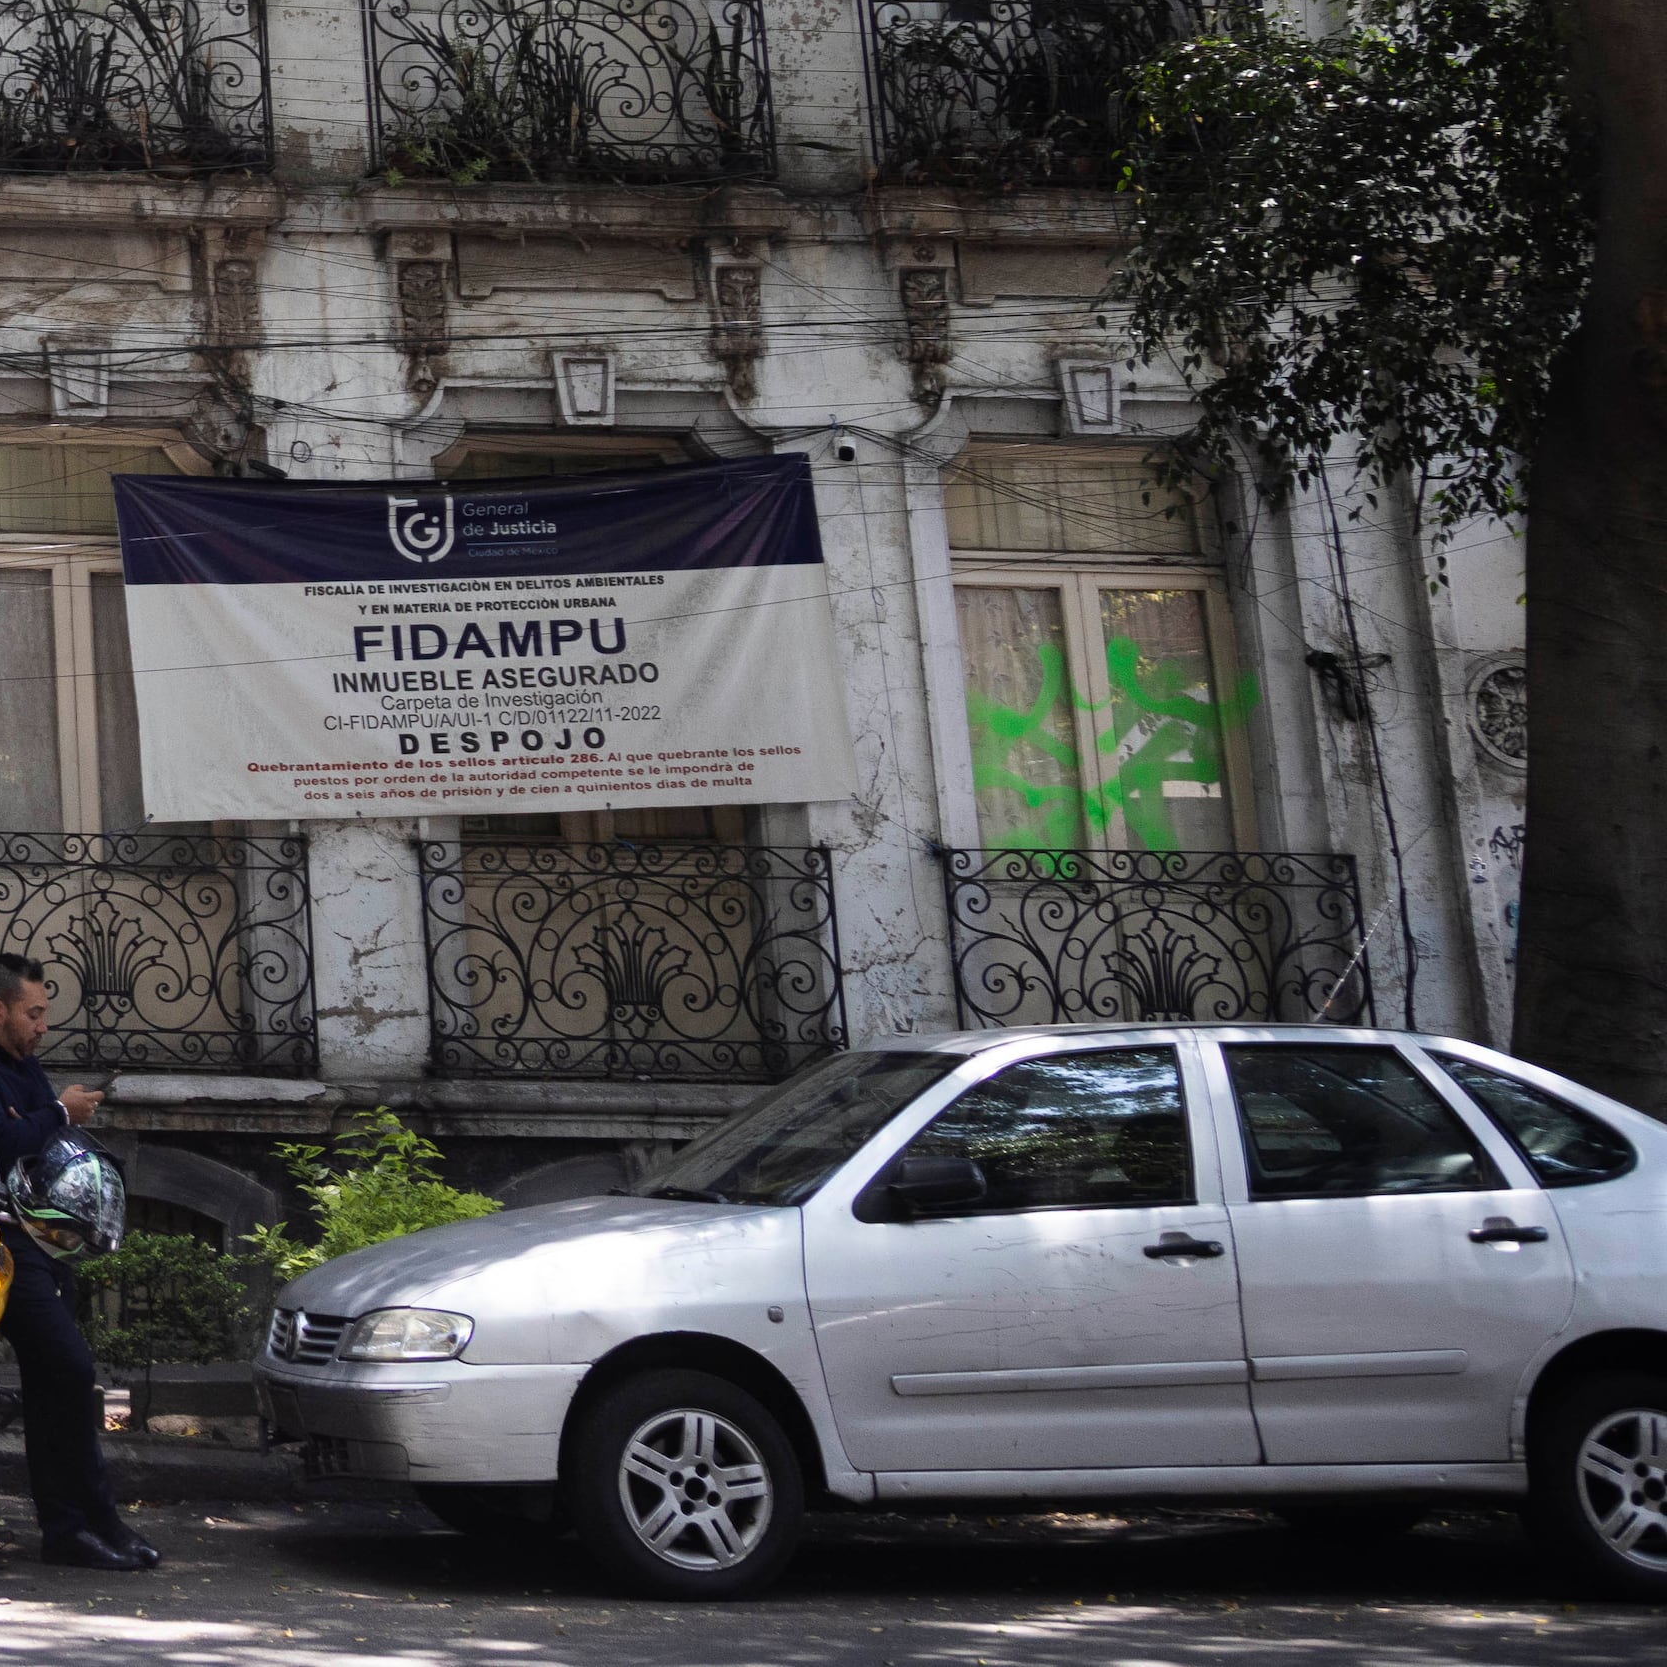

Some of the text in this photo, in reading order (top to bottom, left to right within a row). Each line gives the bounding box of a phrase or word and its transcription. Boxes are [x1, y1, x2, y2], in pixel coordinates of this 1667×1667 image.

[462, 501, 529, 517] General
[462, 519, 557, 537] de Justicia
[468, 547, 505, 558] Ciudad
[508, 547, 520, 556] de
[368, 584, 385, 595] DE
[495, 580, 512, 591] EN
[517, 578, 571, 591] DELITOS
[576, 574, 665, 588] AMBIENTALES
[358, 604, 368, 615] Y
[371, 604, 390, 615] EN
[393, 602, 452, 614] MATERIA
[455, 601, 472, 612] DE
[563, 596, 617, 608] URBANA
[353, 617, 627, 662] FIDAMPU
[333, 662, 659, 693] INMUEBLE ASEGURADO
[381, 689, 603, 712] Carpeta de Investigación
[323, 705, 662, 731] CI-FIDAMPU/A/UI-1 C/D/01122/11-2022
[247, 760, 388, 772] Quebrantamiento
[394, 759, 414, 769] de
[419, 758, 443, 769] los
[449, 756, 496, 767] sellos
[570, 752, 604, 764] 286.
[607, 752, 622, 762] Al
[626, 753, 653, 763] que
[657, 748, 729, 761] quebrante
[733, 747, 754, 756] los
[759, 745, 802, 756] sellos
[294, 776, 350, 788] puestos
[354, 776, 379, 786] por
[383, 774, 425, 784] orden
[430, 773, 447, 782] de
[452, 772, 464, 781] la
[469, 770, 536, 781] autoridad
[540, 768, 623, 780] competente
[628, 766, 644, 776] se
[649, 765, 661, 775] le
[737, 762, 755, 771] de
[304, 791, 330, 800] dos
[334, 792, 342, 800] a
[347, 790, 375, 799] seis
[380, 788, 415, 798] años
[420, 788, 437, 798] de
[496, 787, 505, 798] y
[509, 785, 527, 795] de
[531, 783, 560, 794] cien
[564, 785, 572, 793] a
[577, 780, 652, 793] quinientos
[691, 778, 708, 788] de
[712, 776, 753, 787] multa
